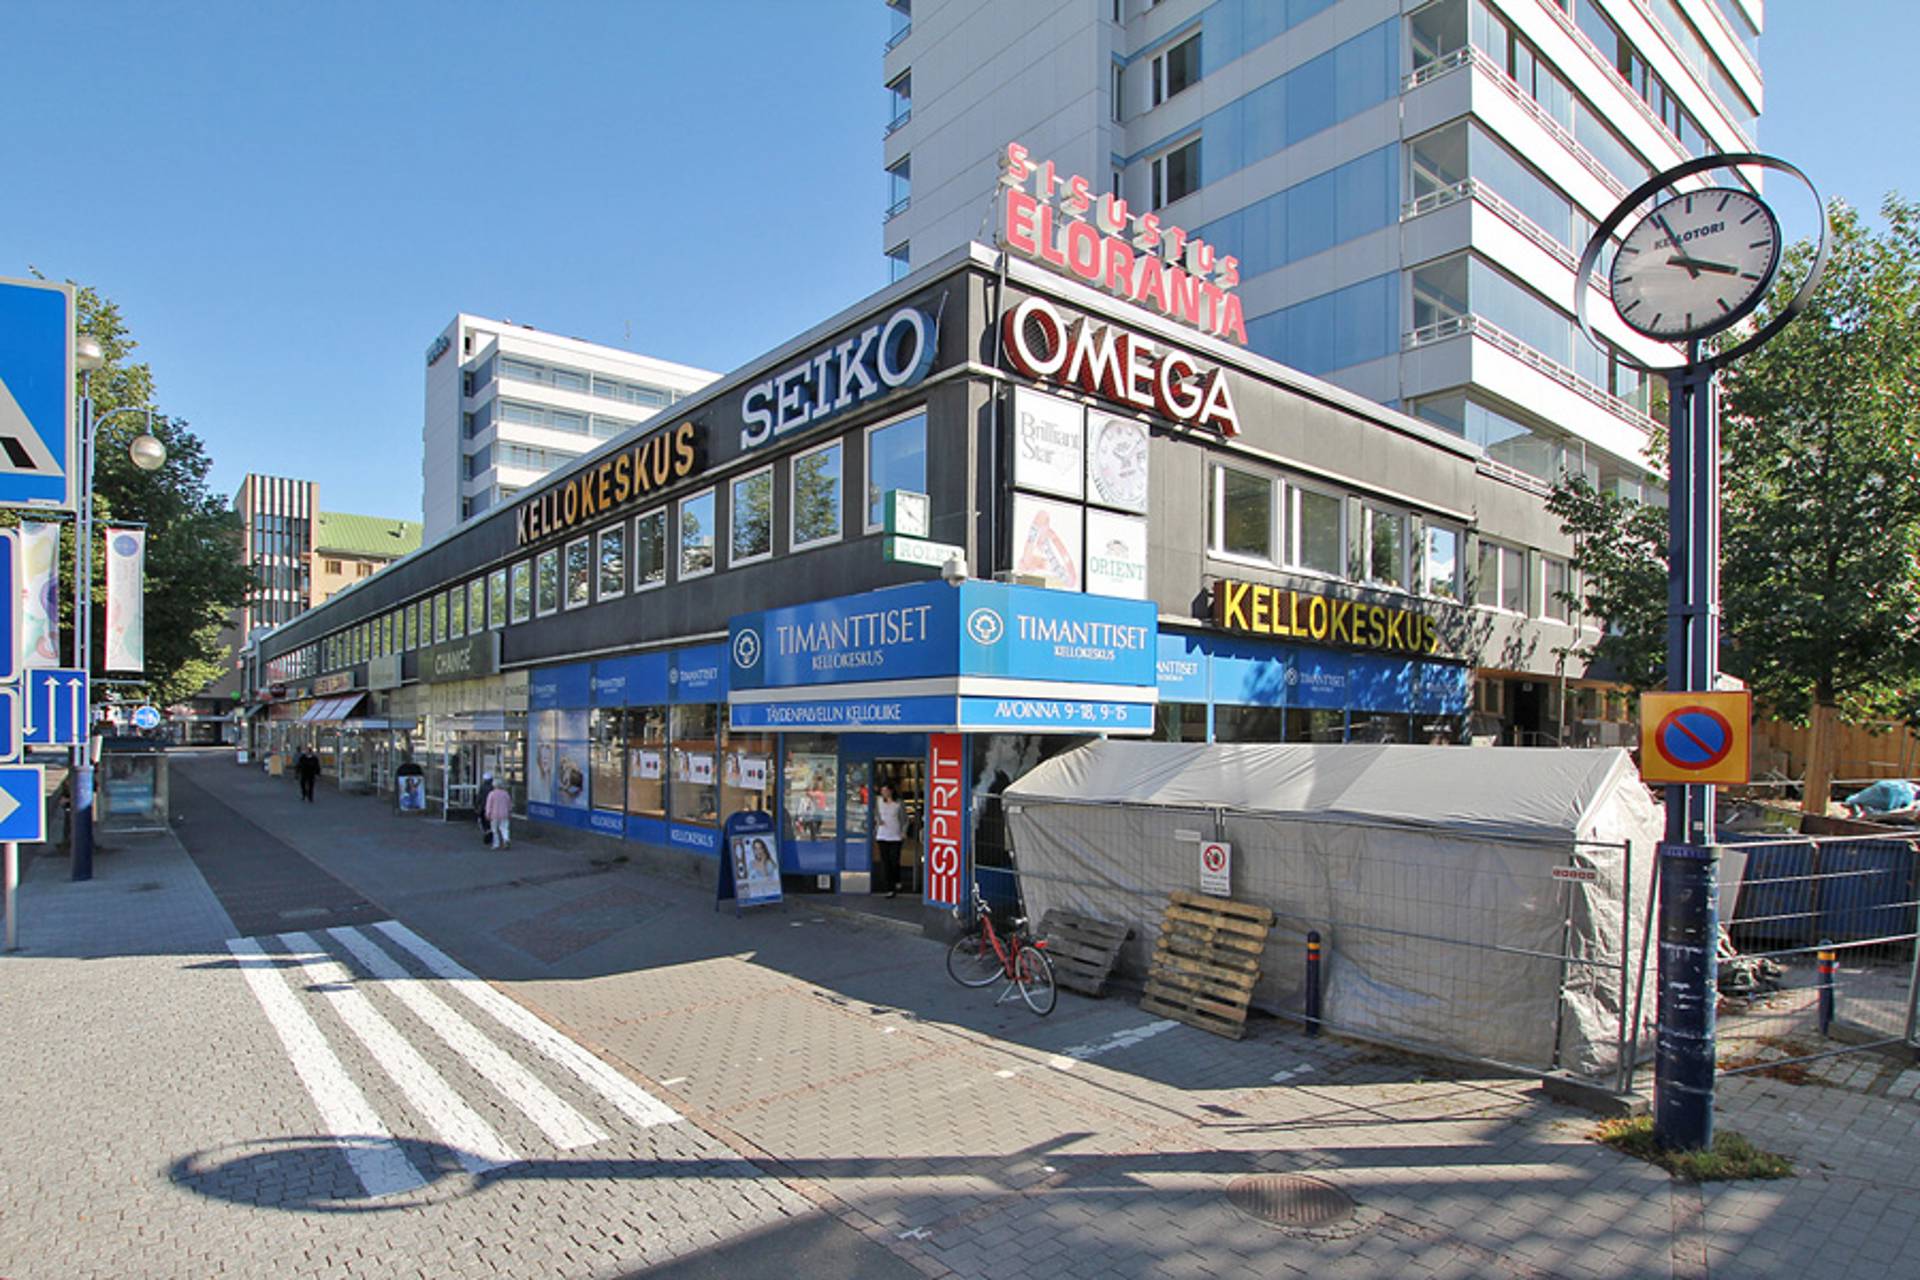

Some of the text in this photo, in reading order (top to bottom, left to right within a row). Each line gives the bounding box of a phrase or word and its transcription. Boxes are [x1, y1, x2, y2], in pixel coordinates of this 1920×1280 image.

[1007, 142, 1239, 287] SISUSTUS
[1654, 221, 1725, 250] KELOTORI
[1006, 189, 1248, 345] ELORANTA
[740, 307, 928, 451] SEIKO
[1012, 297, 1242, 435] OMEGA
[1022, 436, 1055, 463] Star
[516, 421, 696, 545] KELLOKESKUS
[1090, 556, 1145, 581] ORIENT
[776, 605, 932, 656] TIMANTTISET
[1017, 614, 1148, 650] TIMANTTISET
[1223, 580, 1438, 653] KELLOKESKUS
[812, 650, 884, 671] KELLOKESKUS
[1054, 645, 1115, 660] KELLOKESKUS
[994, 701, 1128, 721] AVOINNA 9-18, 9-15
[931, 748, 959, 905] ESPRIT
